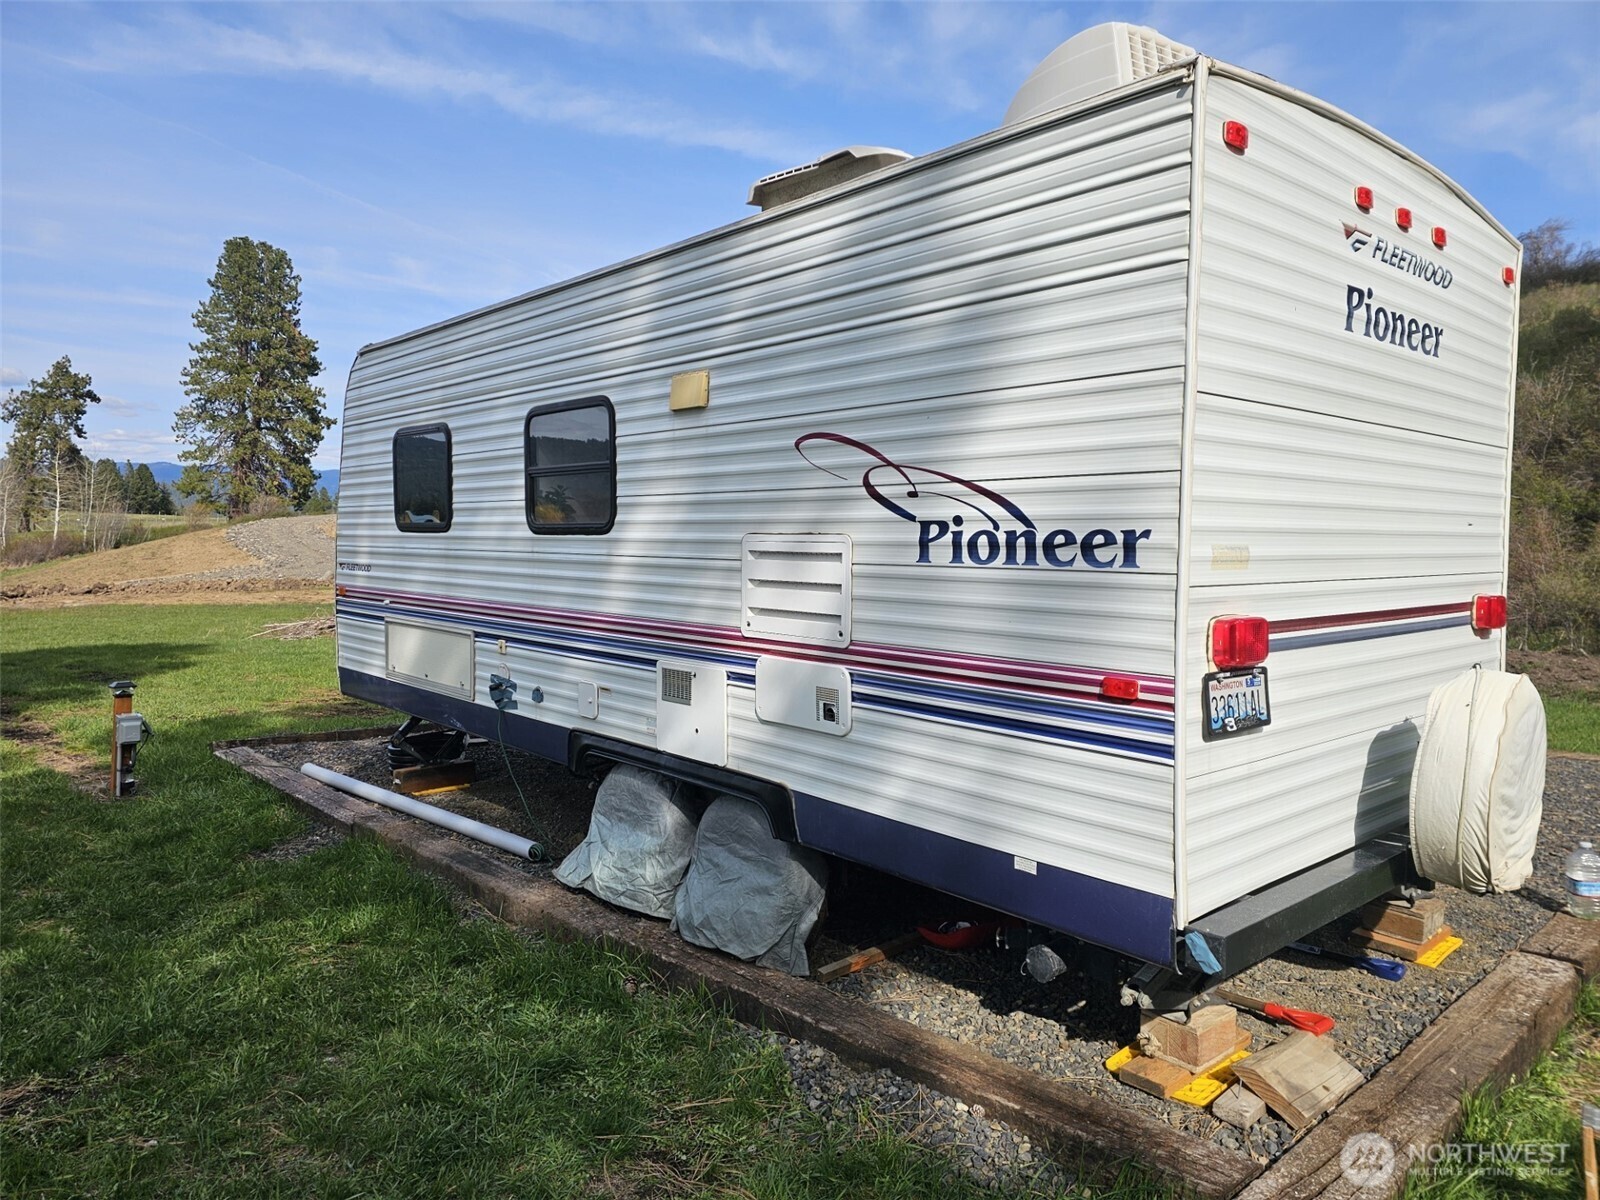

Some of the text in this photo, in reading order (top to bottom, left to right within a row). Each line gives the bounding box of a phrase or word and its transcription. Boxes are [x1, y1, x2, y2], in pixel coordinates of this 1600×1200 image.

[1372, 237, 1453, 289] FLEETWOOD
[1344, 284, 1444, 358] Pioneer
[916, 514, 1152, 569] Pioneer
[1210, 680, 1244, 692] WASHINGTON
